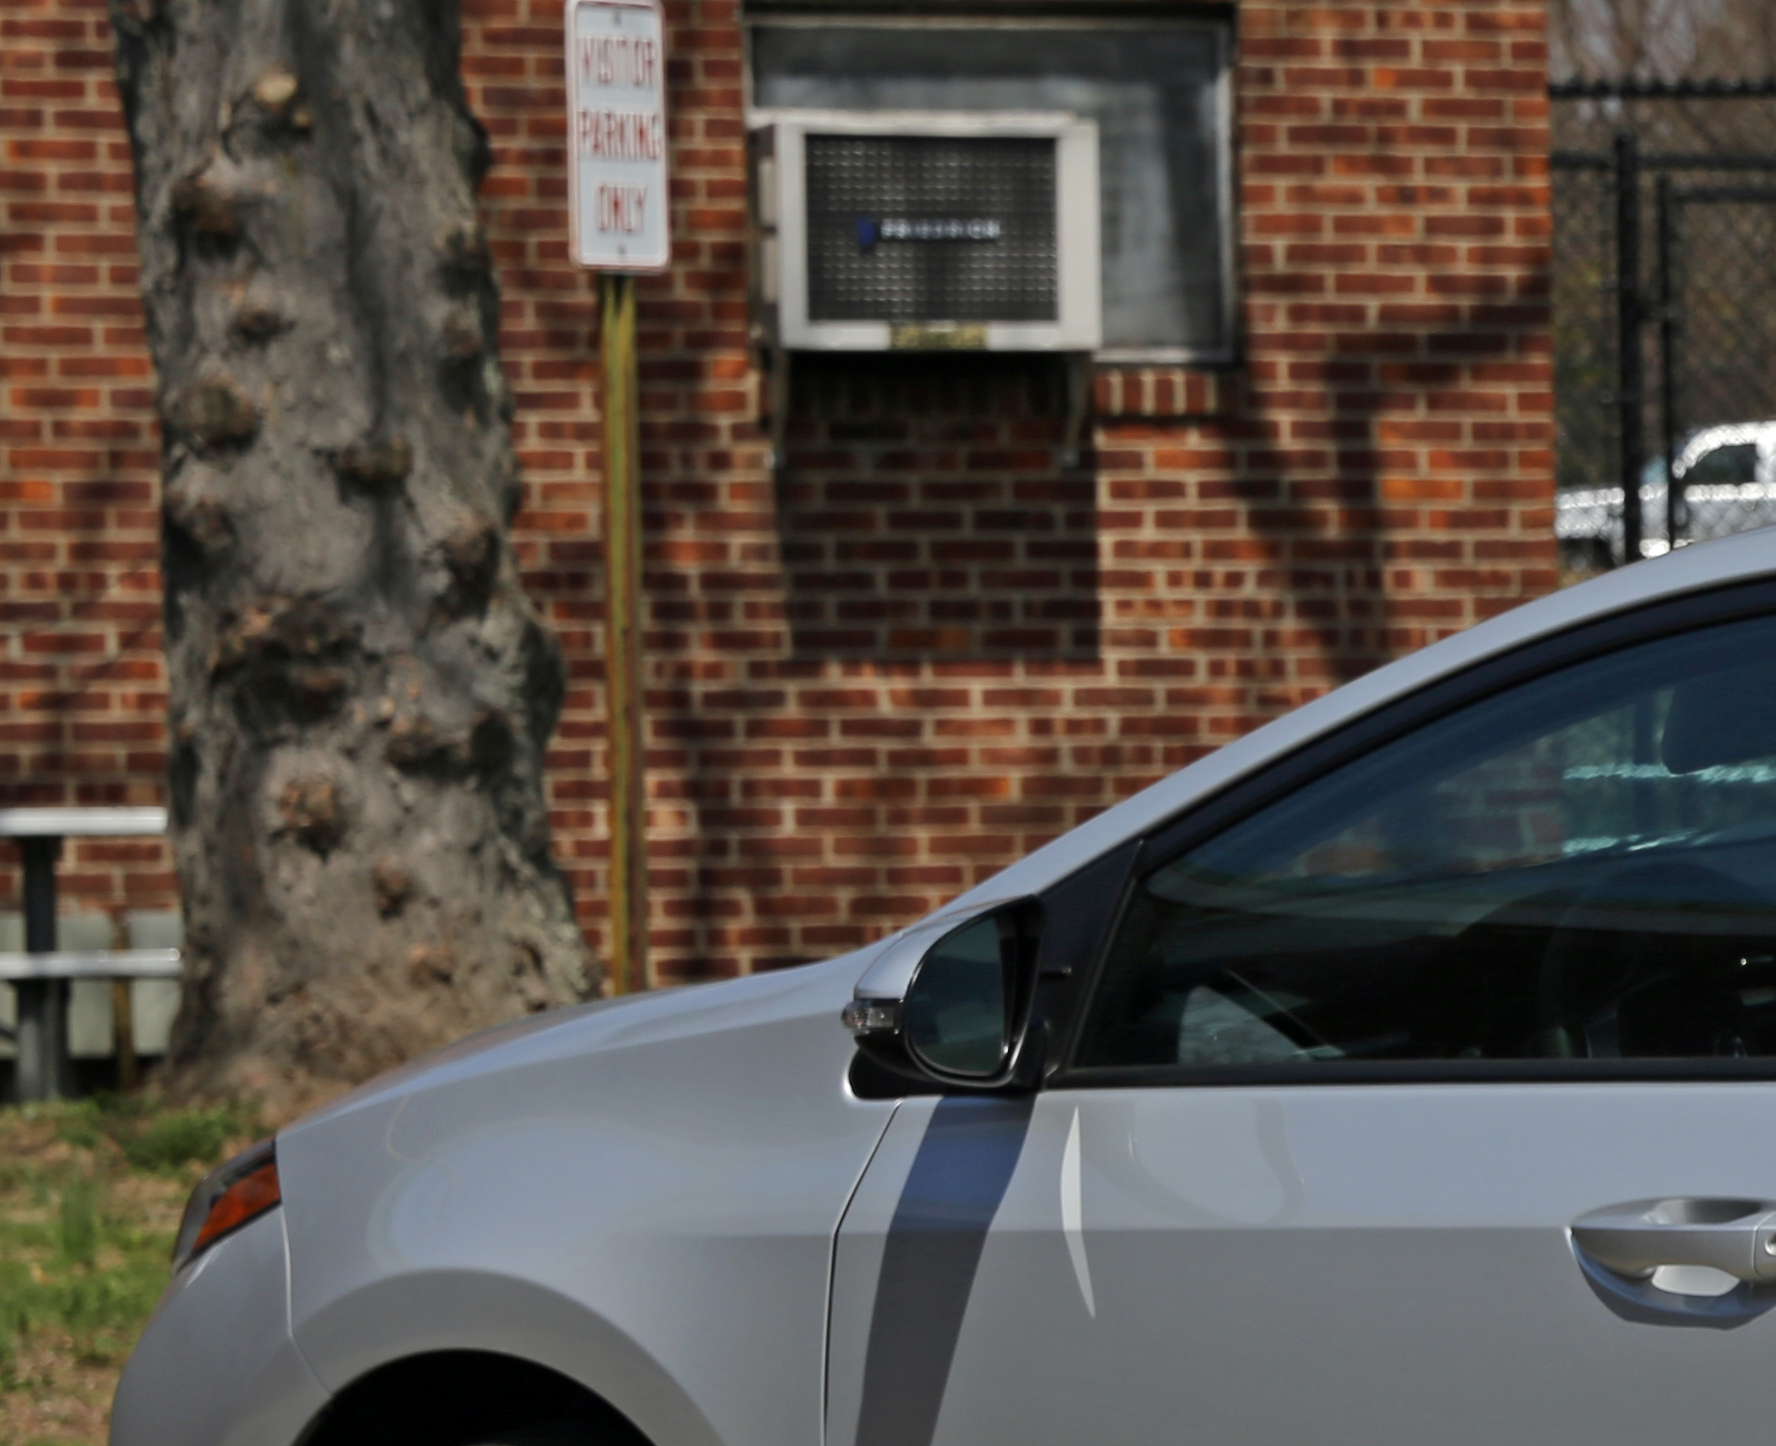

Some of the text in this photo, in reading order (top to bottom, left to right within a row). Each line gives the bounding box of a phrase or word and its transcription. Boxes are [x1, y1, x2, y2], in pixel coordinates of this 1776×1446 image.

[577, 37, 656, 87] VISITOR
[578, 111, 660, 161] PARKING
[597, 184, 647, 233] ONLY
